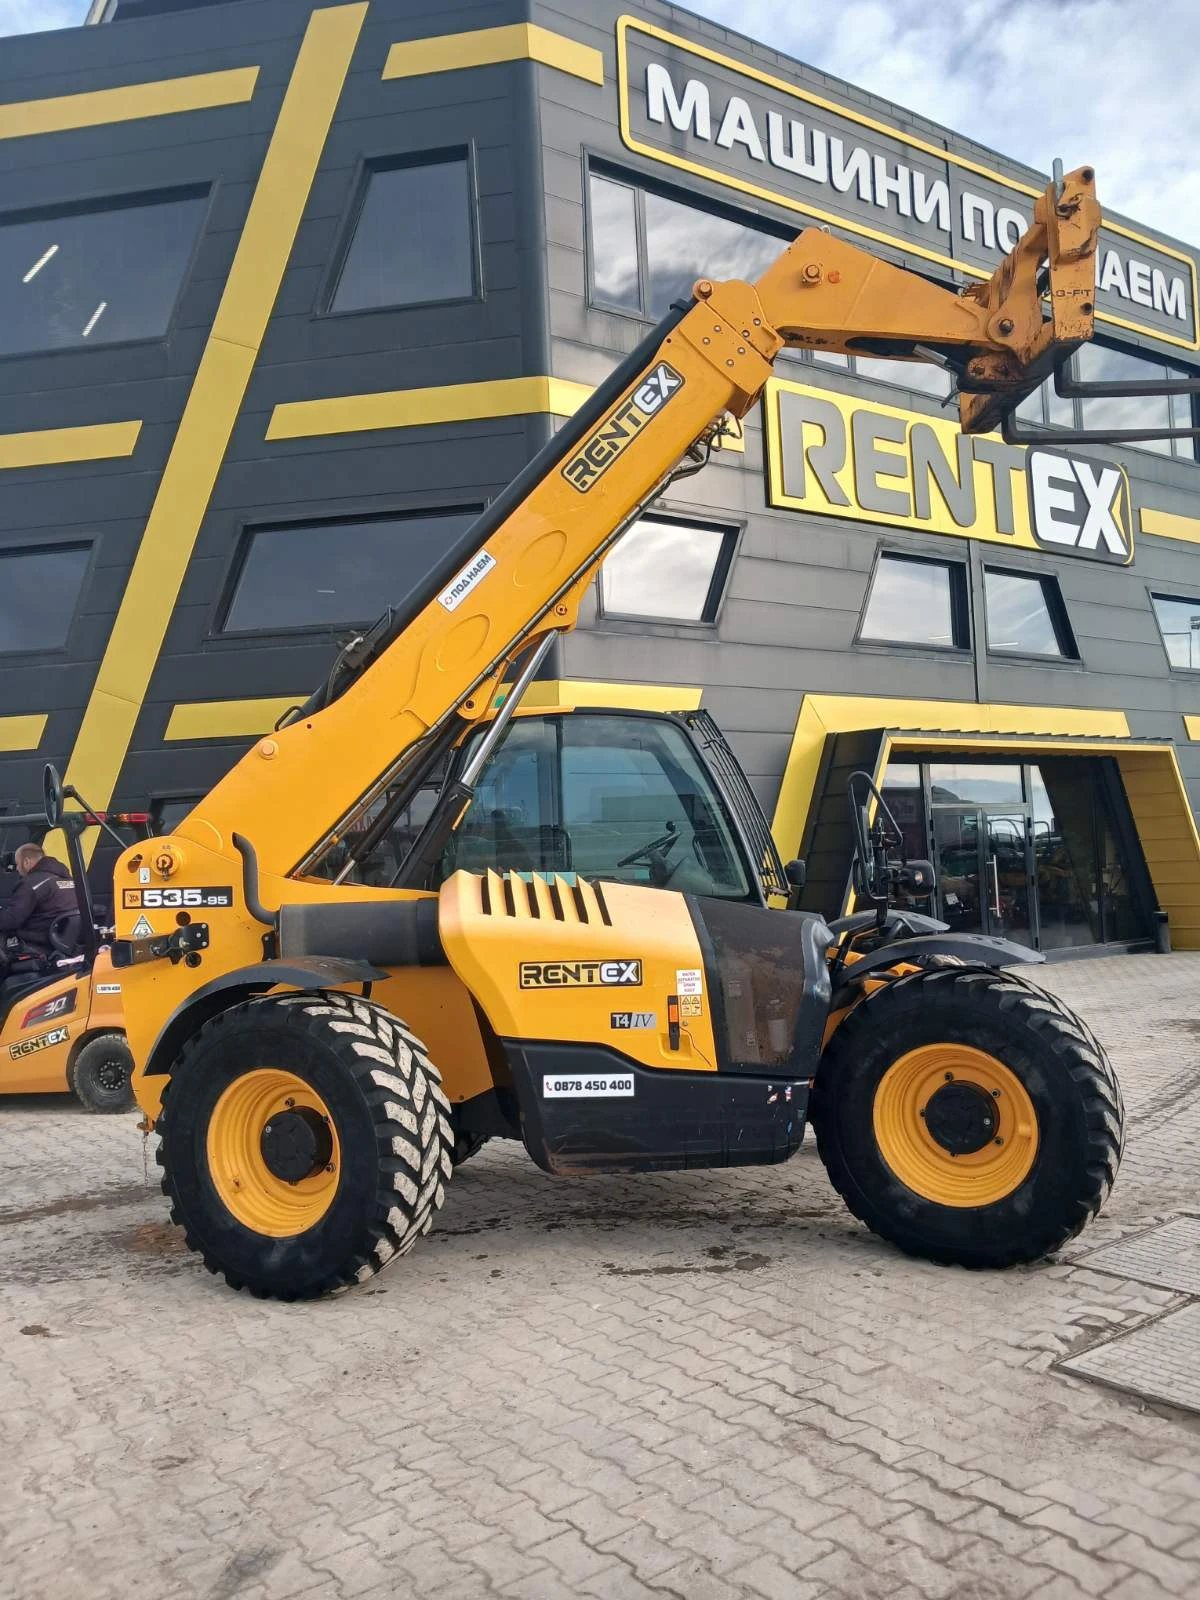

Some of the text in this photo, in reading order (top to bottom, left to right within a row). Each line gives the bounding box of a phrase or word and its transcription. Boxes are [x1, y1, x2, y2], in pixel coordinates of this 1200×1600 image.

[646, 63, 951, 232] МАШИНИ
[962, 191, 1036, 260] ПО
[566, 366, 681, 489] RENTEX
[779, 389, 1129, 556] RENTEX
[451, 554, 491, 599] ПОД НАЕМ
[523, 962, 639, 985] RENTEX
[44, 996, 67, 1016] 30
[11, 1028, 67, 1058] RENTEX
[554, 1080, 631, 1091] 0878 450 400
